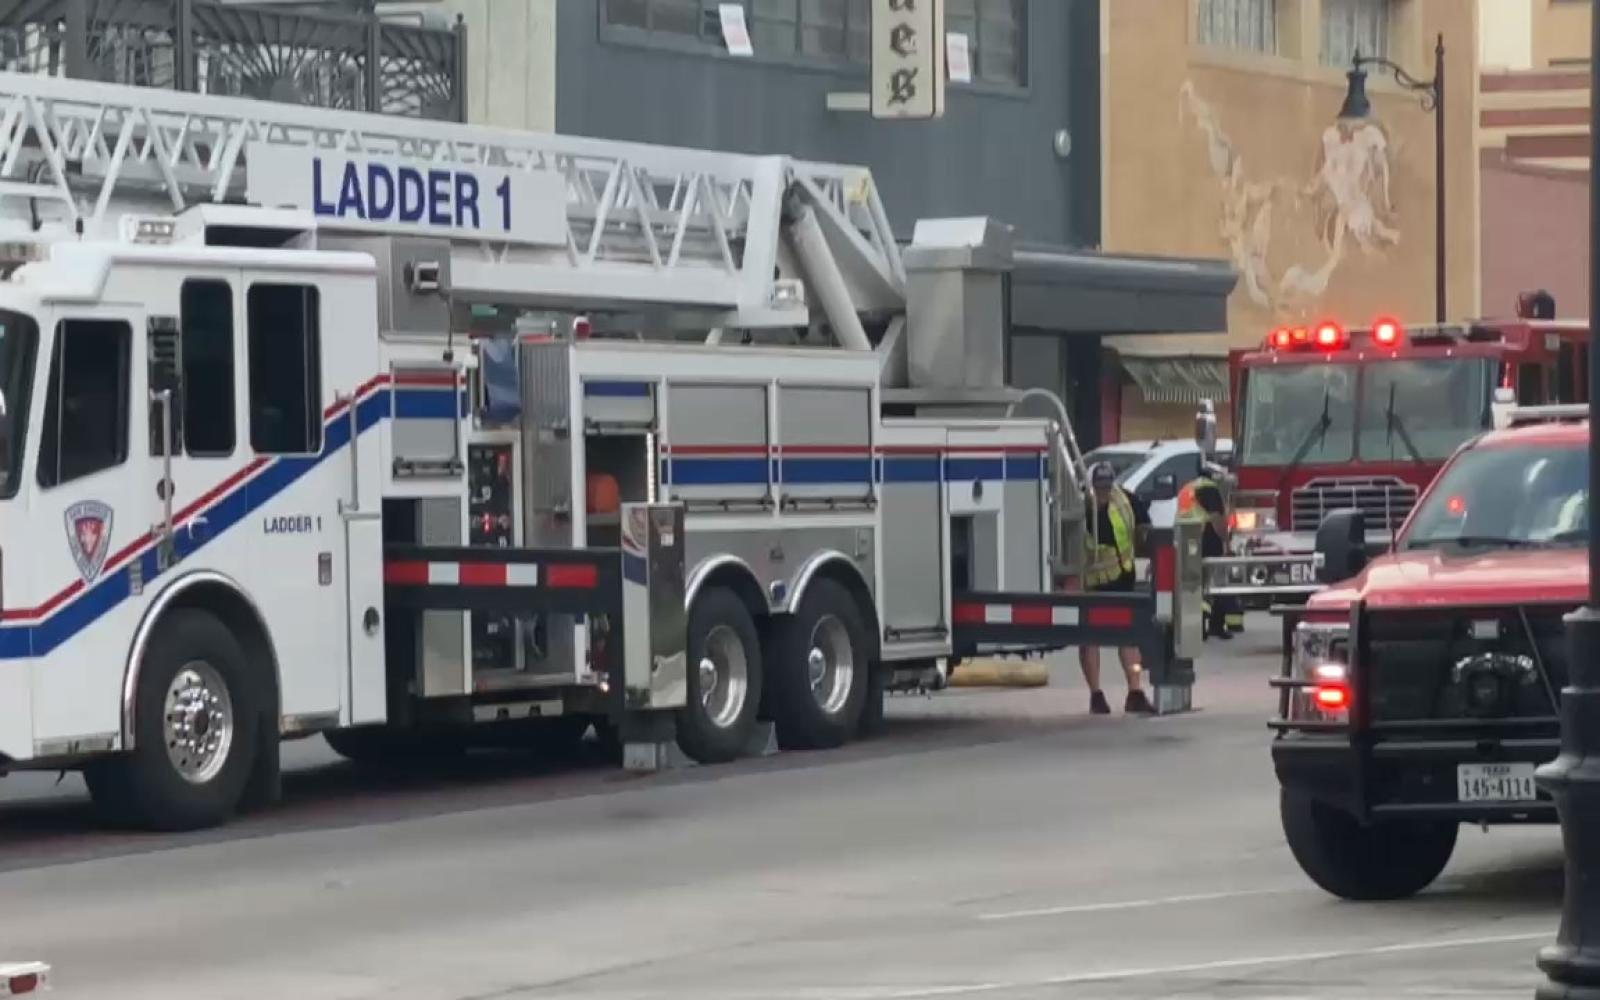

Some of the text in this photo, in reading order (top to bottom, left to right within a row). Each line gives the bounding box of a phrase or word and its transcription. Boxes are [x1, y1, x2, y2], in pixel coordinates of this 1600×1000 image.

[313, 157, 511, 231] LADDER 1
[263, 515, 322, 534] LADDER 1
